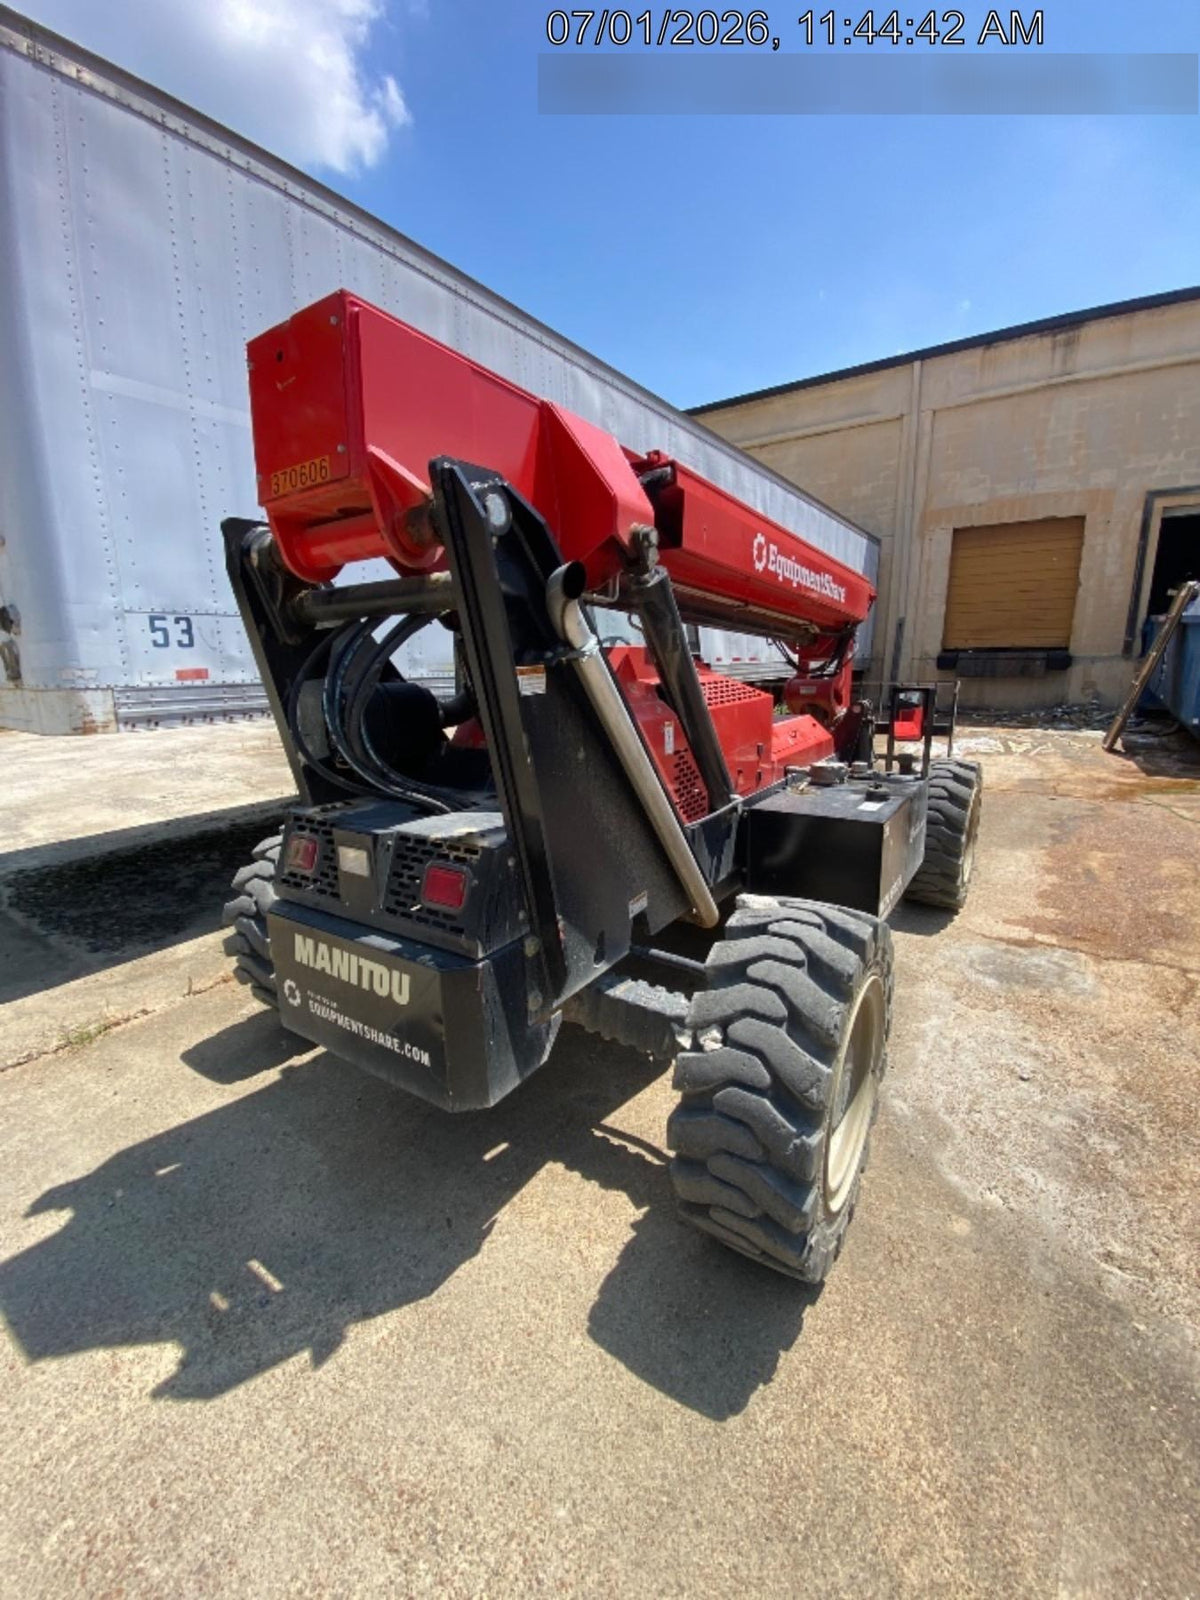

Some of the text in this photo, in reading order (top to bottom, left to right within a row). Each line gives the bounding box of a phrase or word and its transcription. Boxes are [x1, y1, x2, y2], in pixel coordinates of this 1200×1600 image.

[273, 458, 328, 495] 370606
[148, 615, 195, 648] 53
[294, 933, 411, 1005] MANITOU
[308, 999, 431, 1067] EQUIPMENTSHARE.COM
